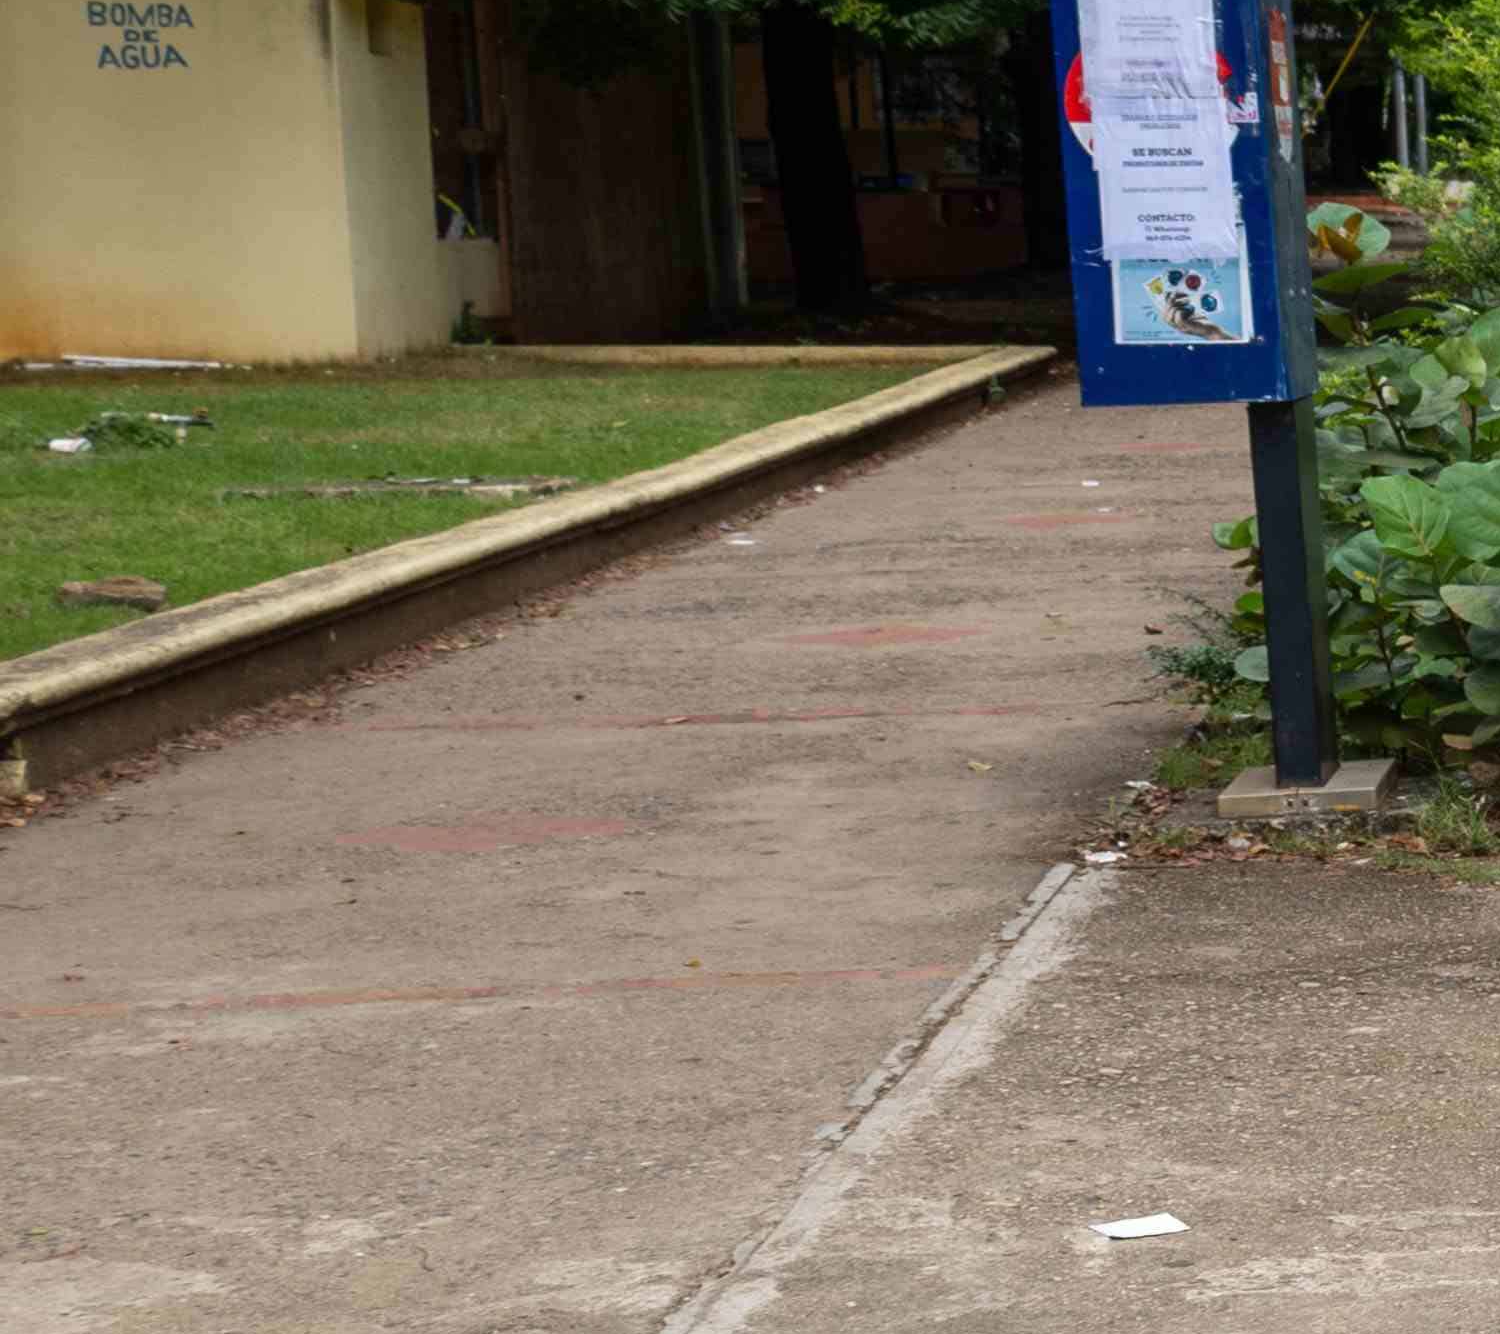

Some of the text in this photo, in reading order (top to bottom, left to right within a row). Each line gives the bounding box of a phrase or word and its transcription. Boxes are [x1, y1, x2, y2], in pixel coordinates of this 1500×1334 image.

[87, 0, 195, 28] BOMBA
[123, 28, 160, 42] DE
[97, 43, 190, 69] AGUA
[1148, 147, 1192, 157] BUSCAN
